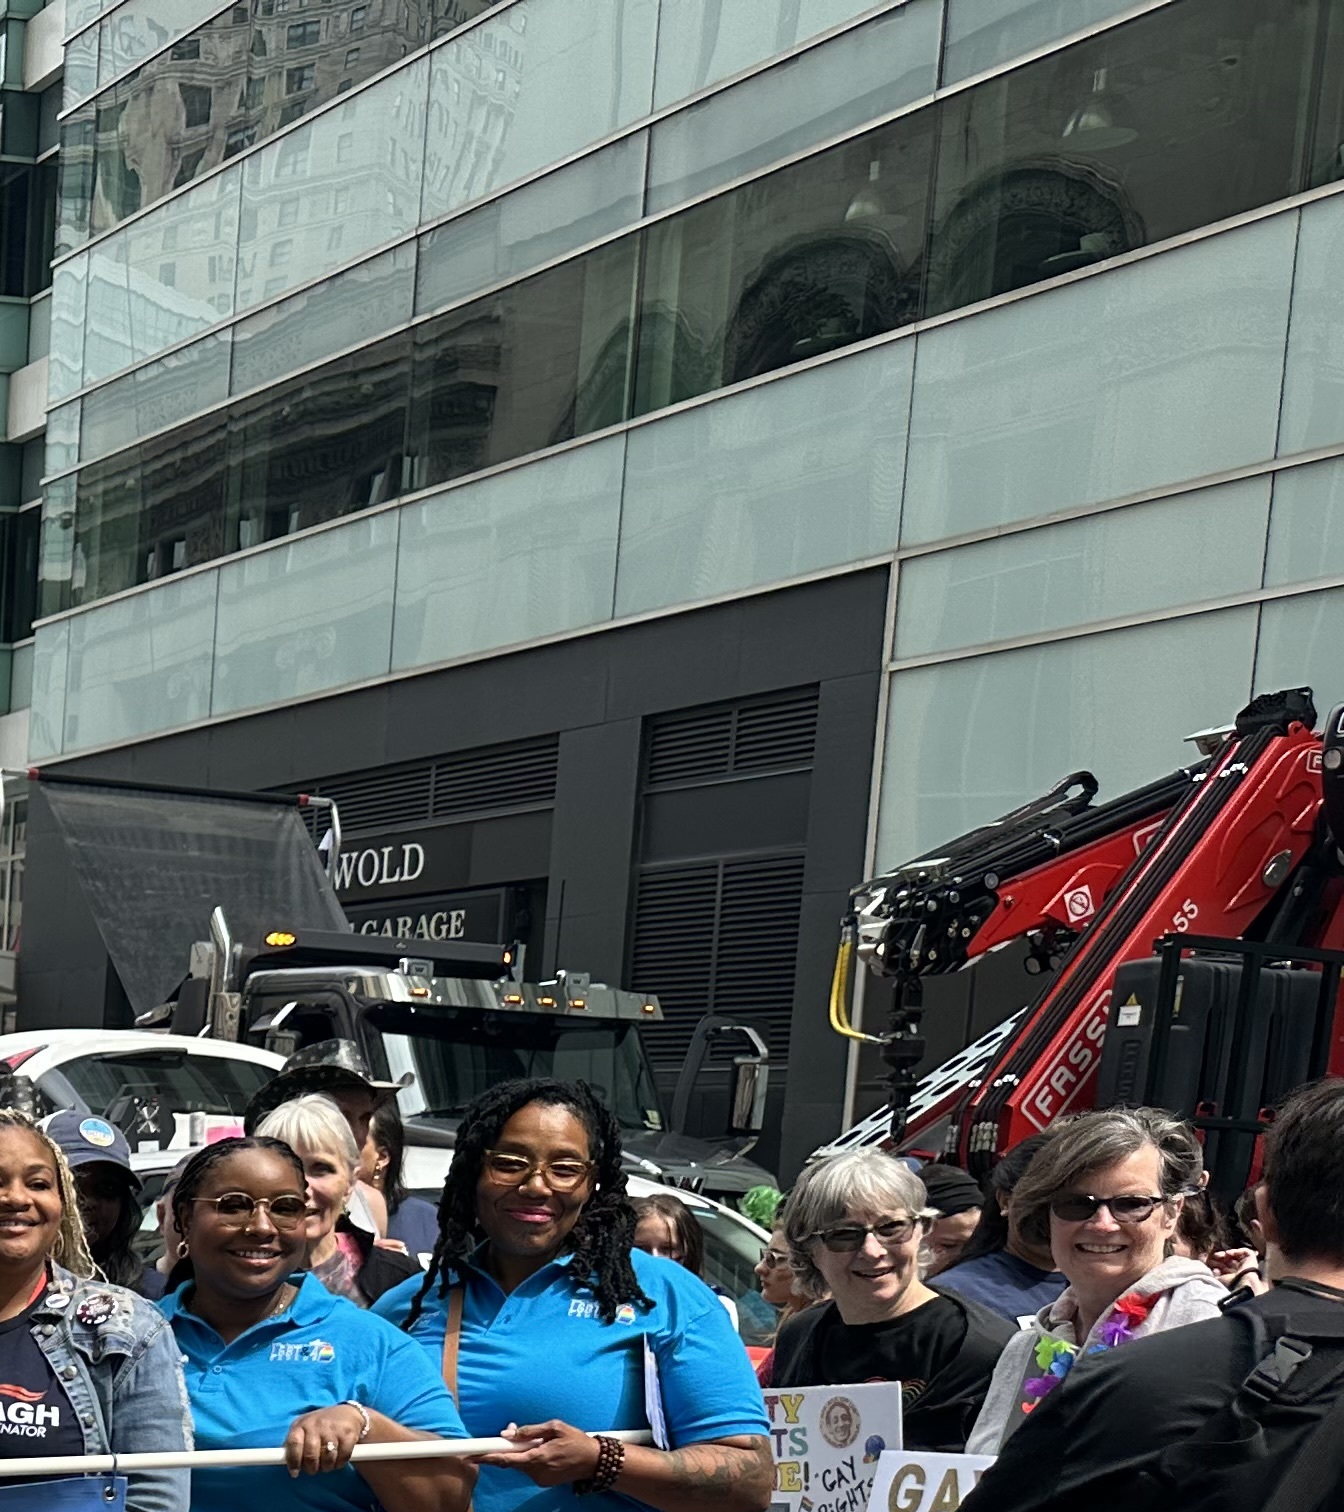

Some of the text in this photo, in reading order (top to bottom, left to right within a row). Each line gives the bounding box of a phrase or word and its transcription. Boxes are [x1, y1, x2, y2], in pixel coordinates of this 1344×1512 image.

[334, 843, 425, 890] WOLD
[361, 909, 466, 941] GARAGE
[1034, 1004, 1110, 1118] FASS
